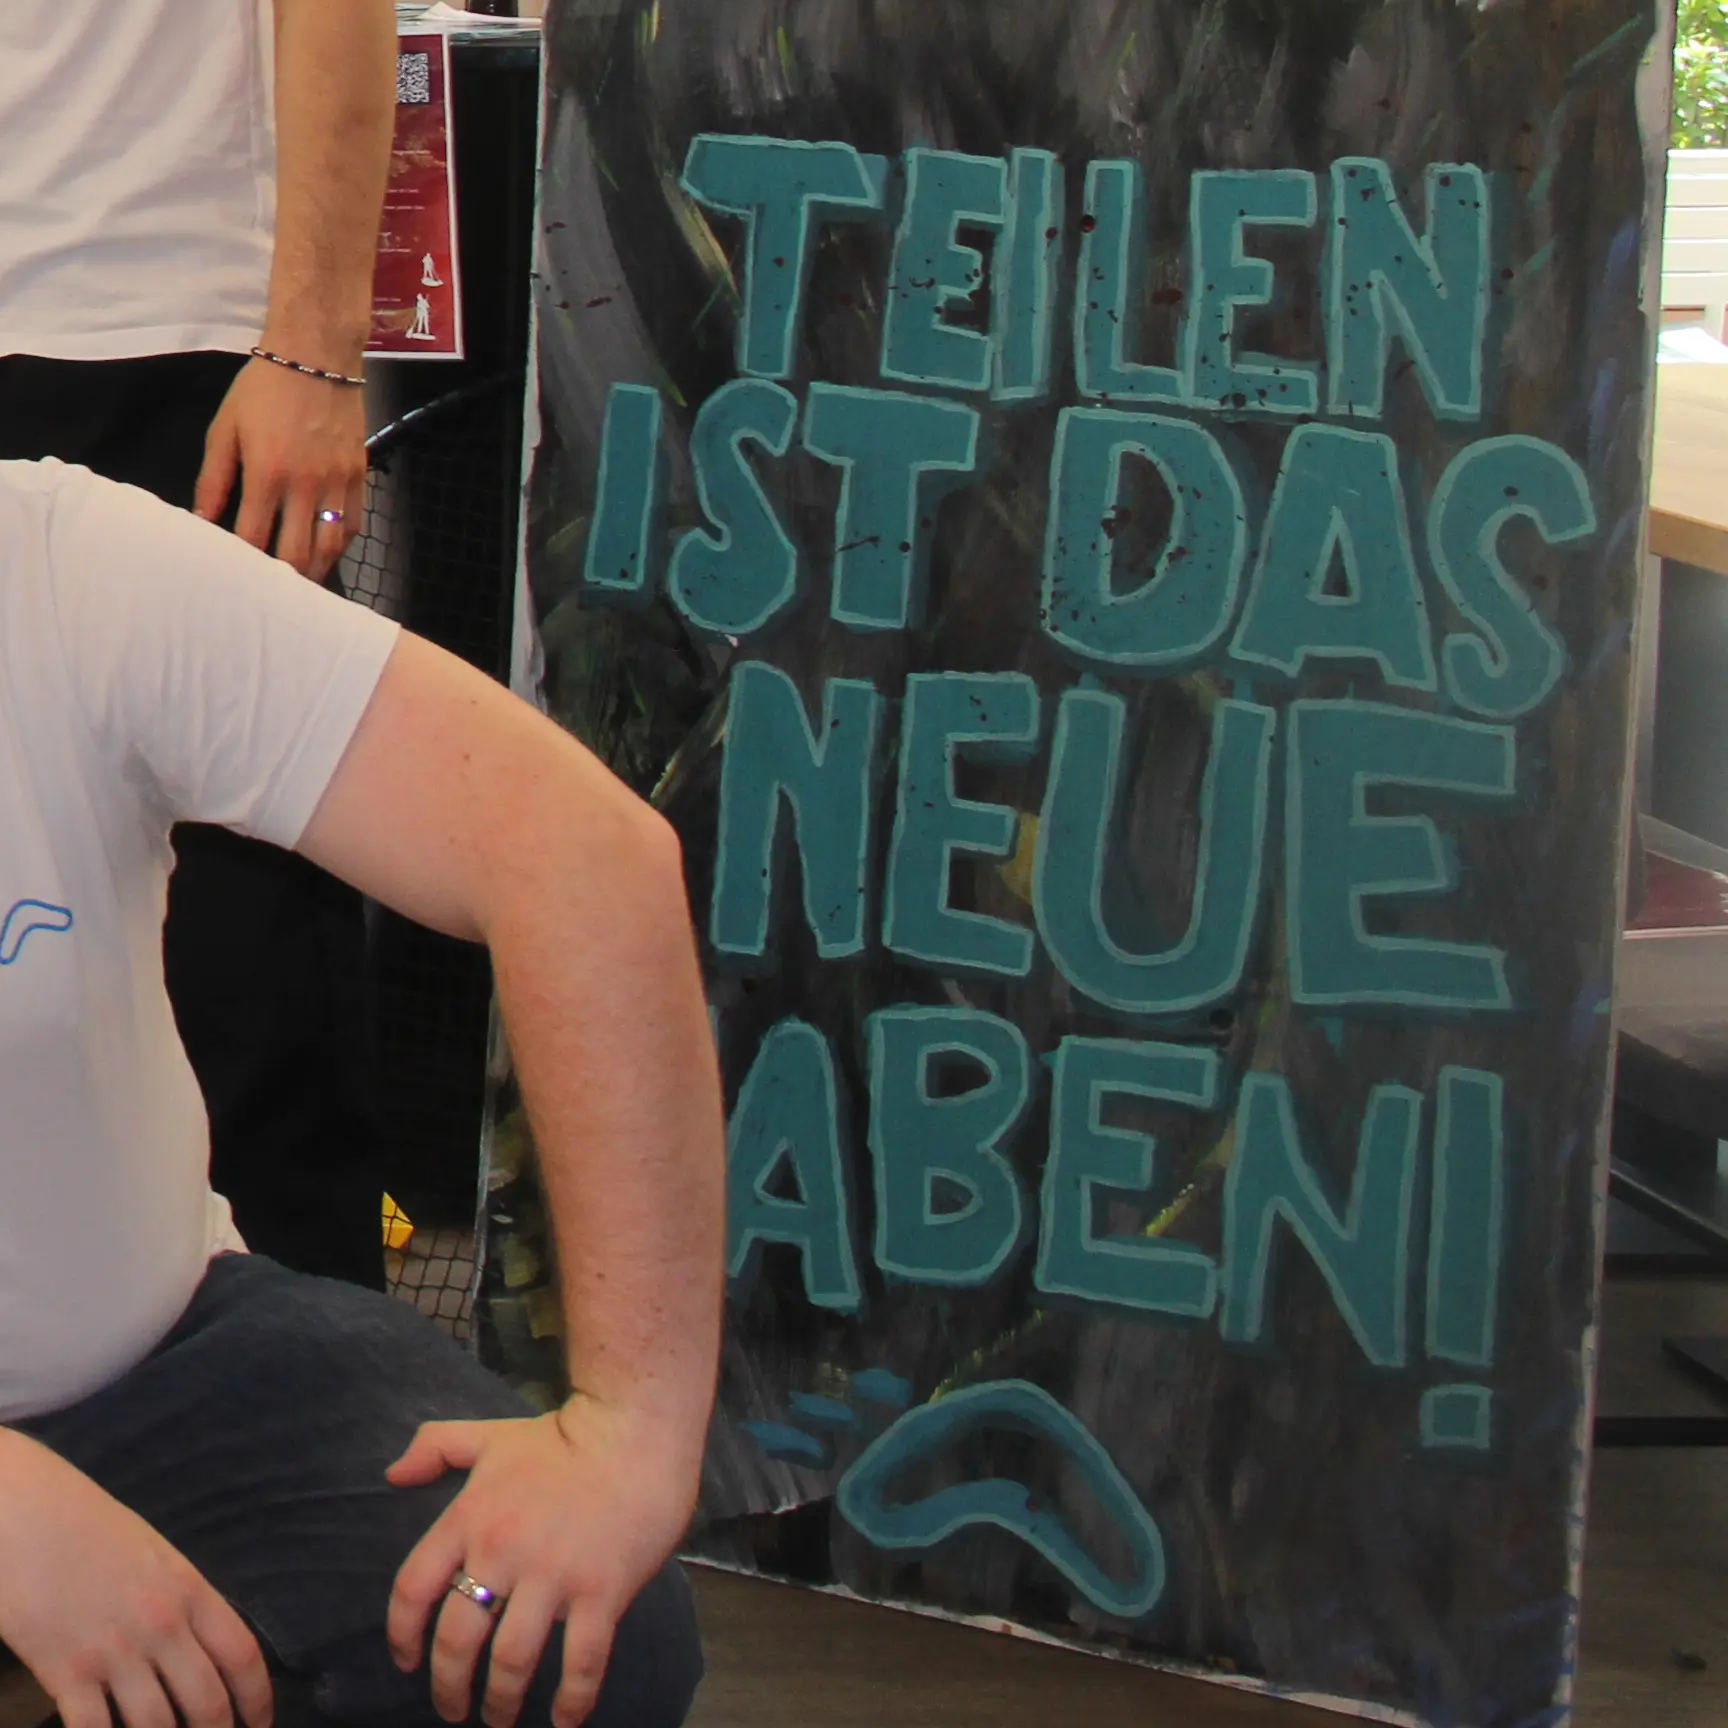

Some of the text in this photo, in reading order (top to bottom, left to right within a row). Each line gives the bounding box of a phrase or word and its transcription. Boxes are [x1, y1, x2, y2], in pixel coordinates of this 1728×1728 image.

[684, 133, 1491, 421] TEILEN
[586, 380, 1599, 717] IST DAS
[709, 661, 1519, 1013] NEUE
[708, 1003, 1506, 1449] ABEN!
